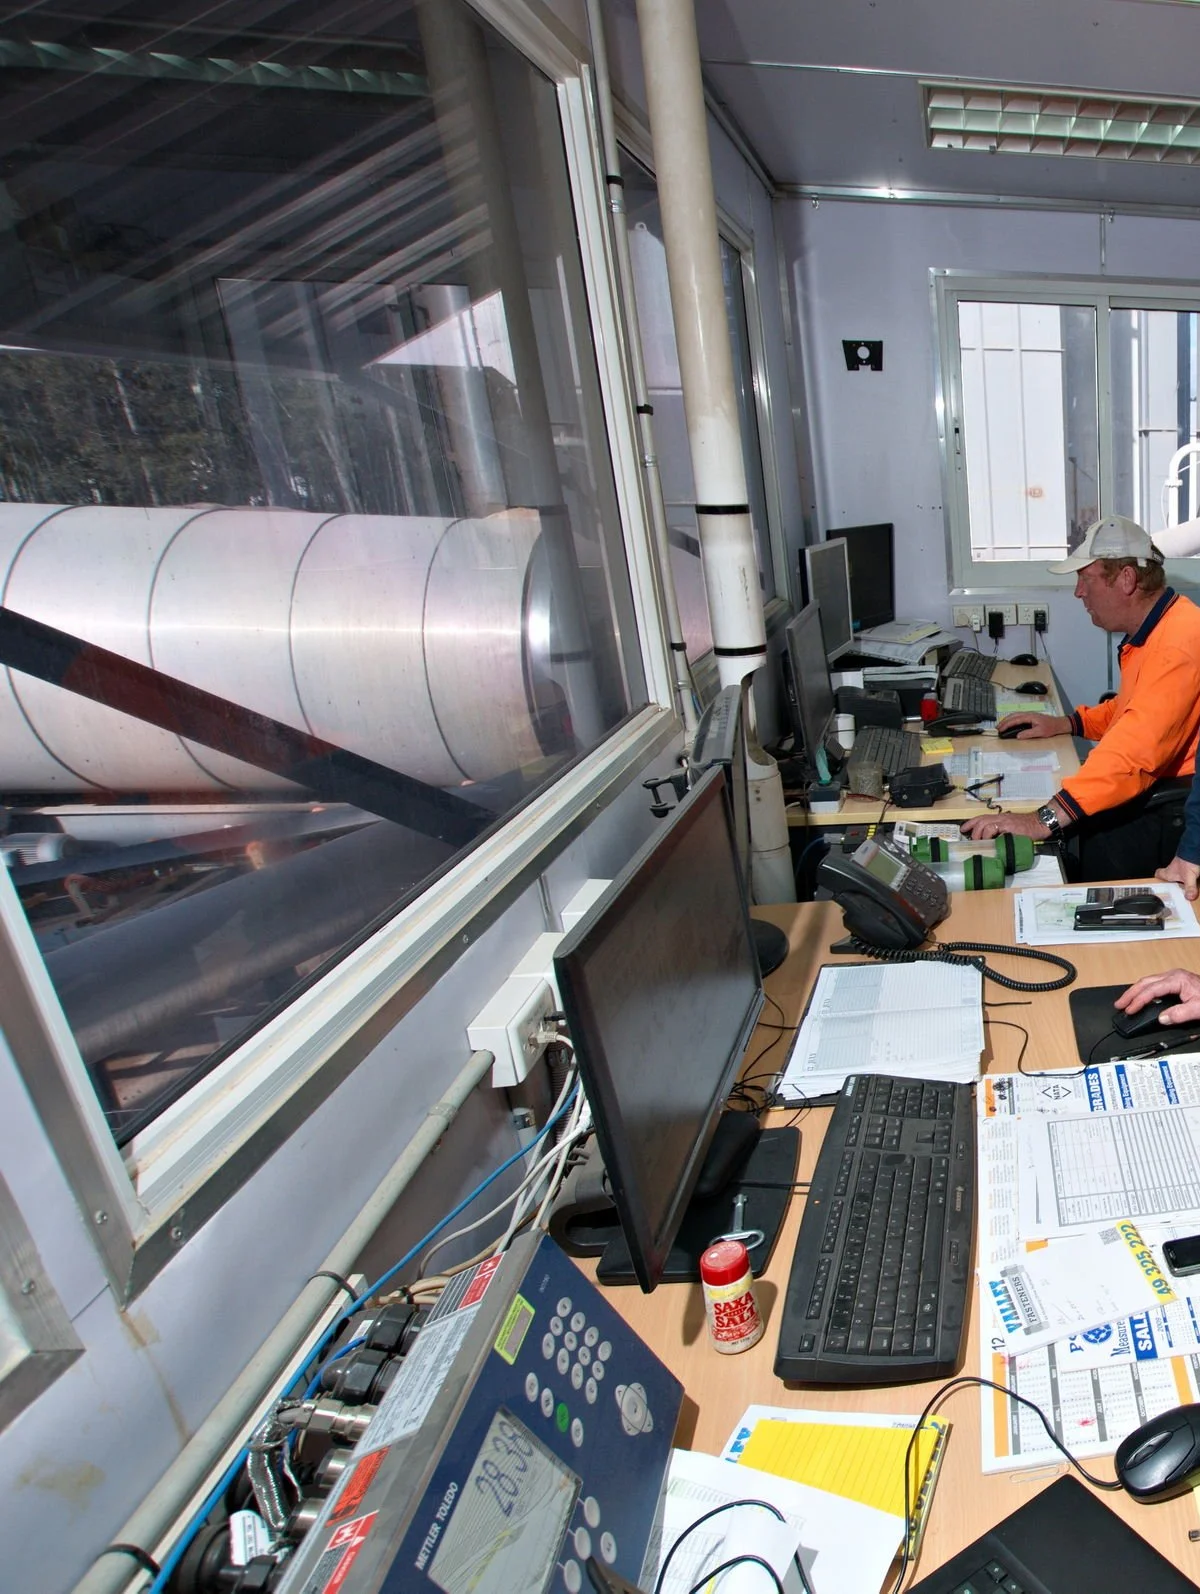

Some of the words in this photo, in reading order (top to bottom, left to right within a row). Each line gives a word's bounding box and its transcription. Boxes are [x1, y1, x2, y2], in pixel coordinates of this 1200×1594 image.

[1053, 1084, 1061, 1100] NATA
[1087, 1073, 1104, 1111] GRADES
[1120, 1223, 1145, 1248] 222
[1136, 1251, 1161, 1276] 325
[1012, 1275, 1037, 1323] FASTENERS
[1152, 1278, 1172, 1295] 49
[714, 1291, 754, 1315] SAXA
[988, 1279, 1023, 1334] VALLEY
[715, 1305, 756, 1328] SALT
[991, 1337, 1006, 1350] 12
[1110, 1320, 1130, 1357] Measure
[414, 1522, 442, 1571] METTLER
[436, 1482, 459, 1522] TOLEDO
